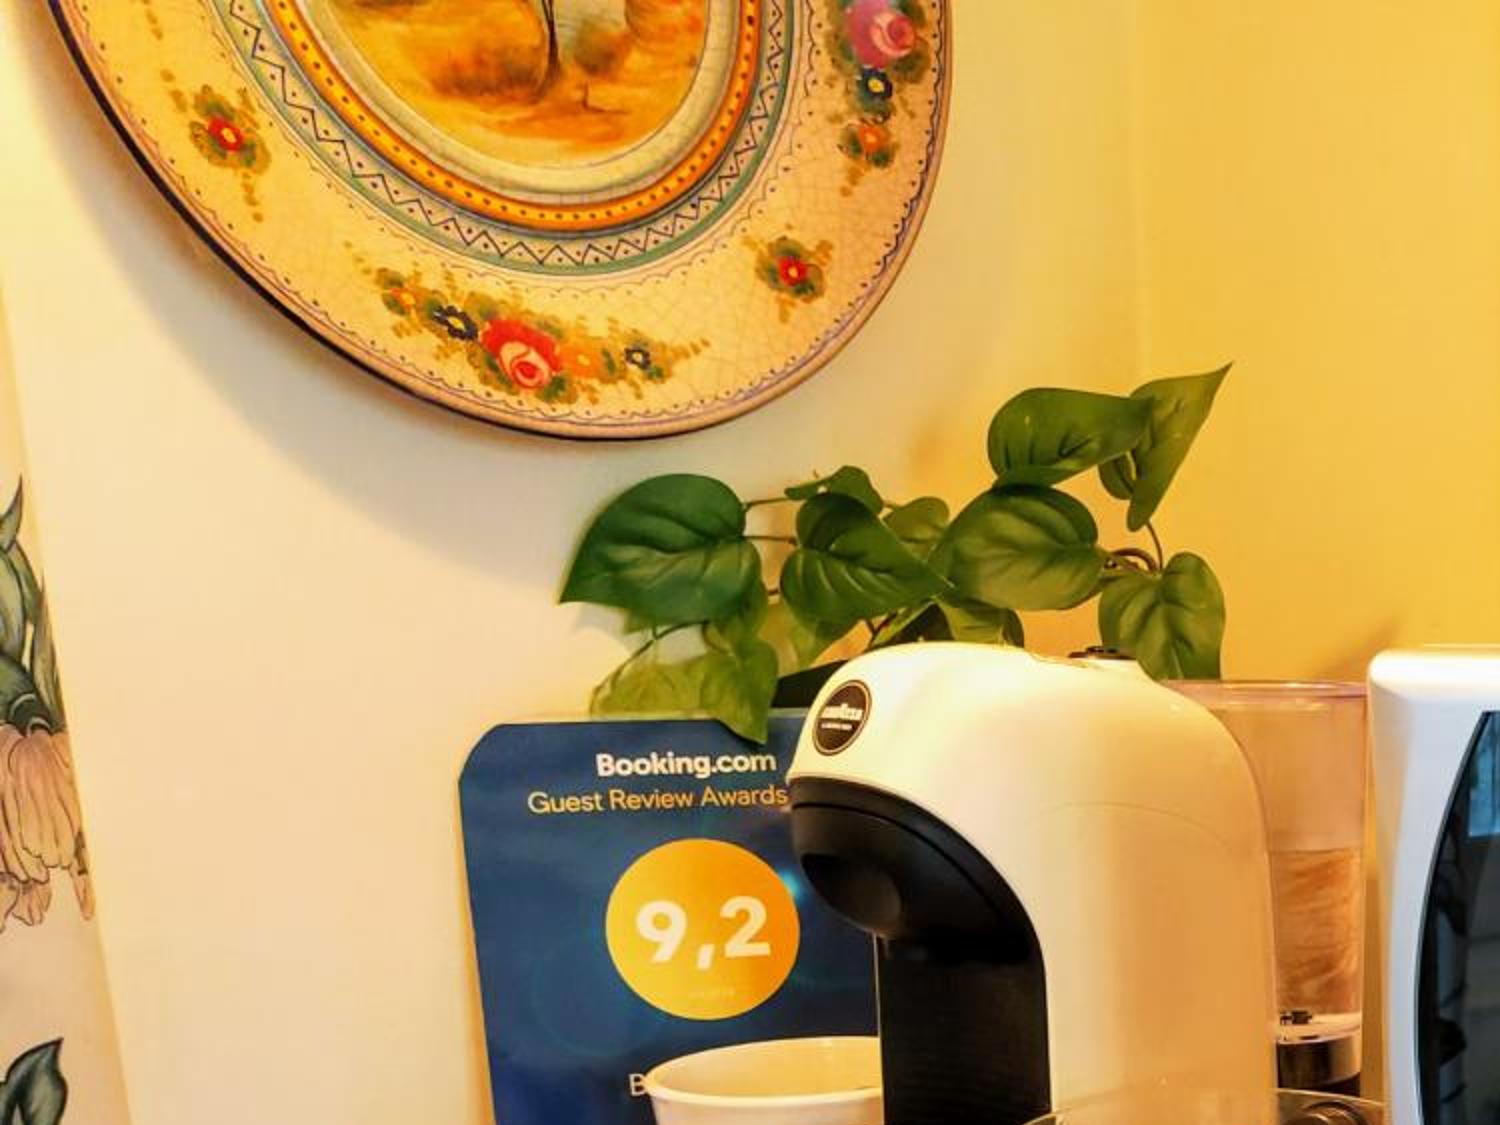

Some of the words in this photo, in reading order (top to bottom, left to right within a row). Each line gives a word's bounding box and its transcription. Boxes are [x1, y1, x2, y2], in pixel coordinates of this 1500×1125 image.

[596, 752, 777, 778] Booking.com
[527, 791, 603, 813] Guest
[608, 788, 694, 810] Review
[701, 784, 789, 806] Awards
[635, 896, 771, 971] 9,2
